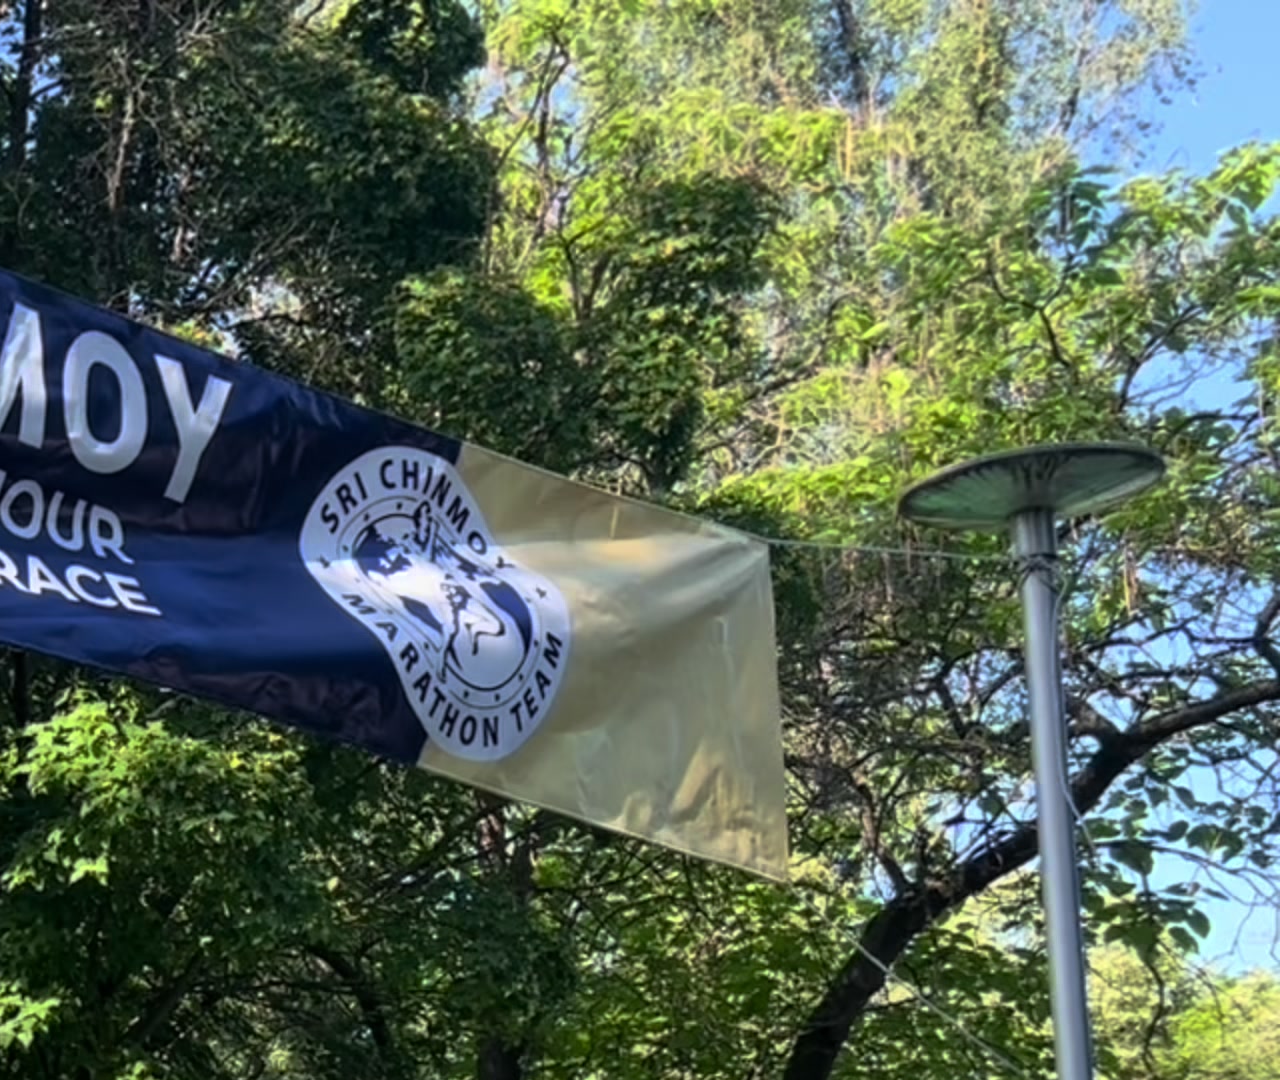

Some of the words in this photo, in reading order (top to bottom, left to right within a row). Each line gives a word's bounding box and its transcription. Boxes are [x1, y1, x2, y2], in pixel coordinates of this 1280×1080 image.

[320, 472, 368, 534] SRI
[341, 592, 501, 748] MARATHON
[509, 631, 564, 733] TEAM
